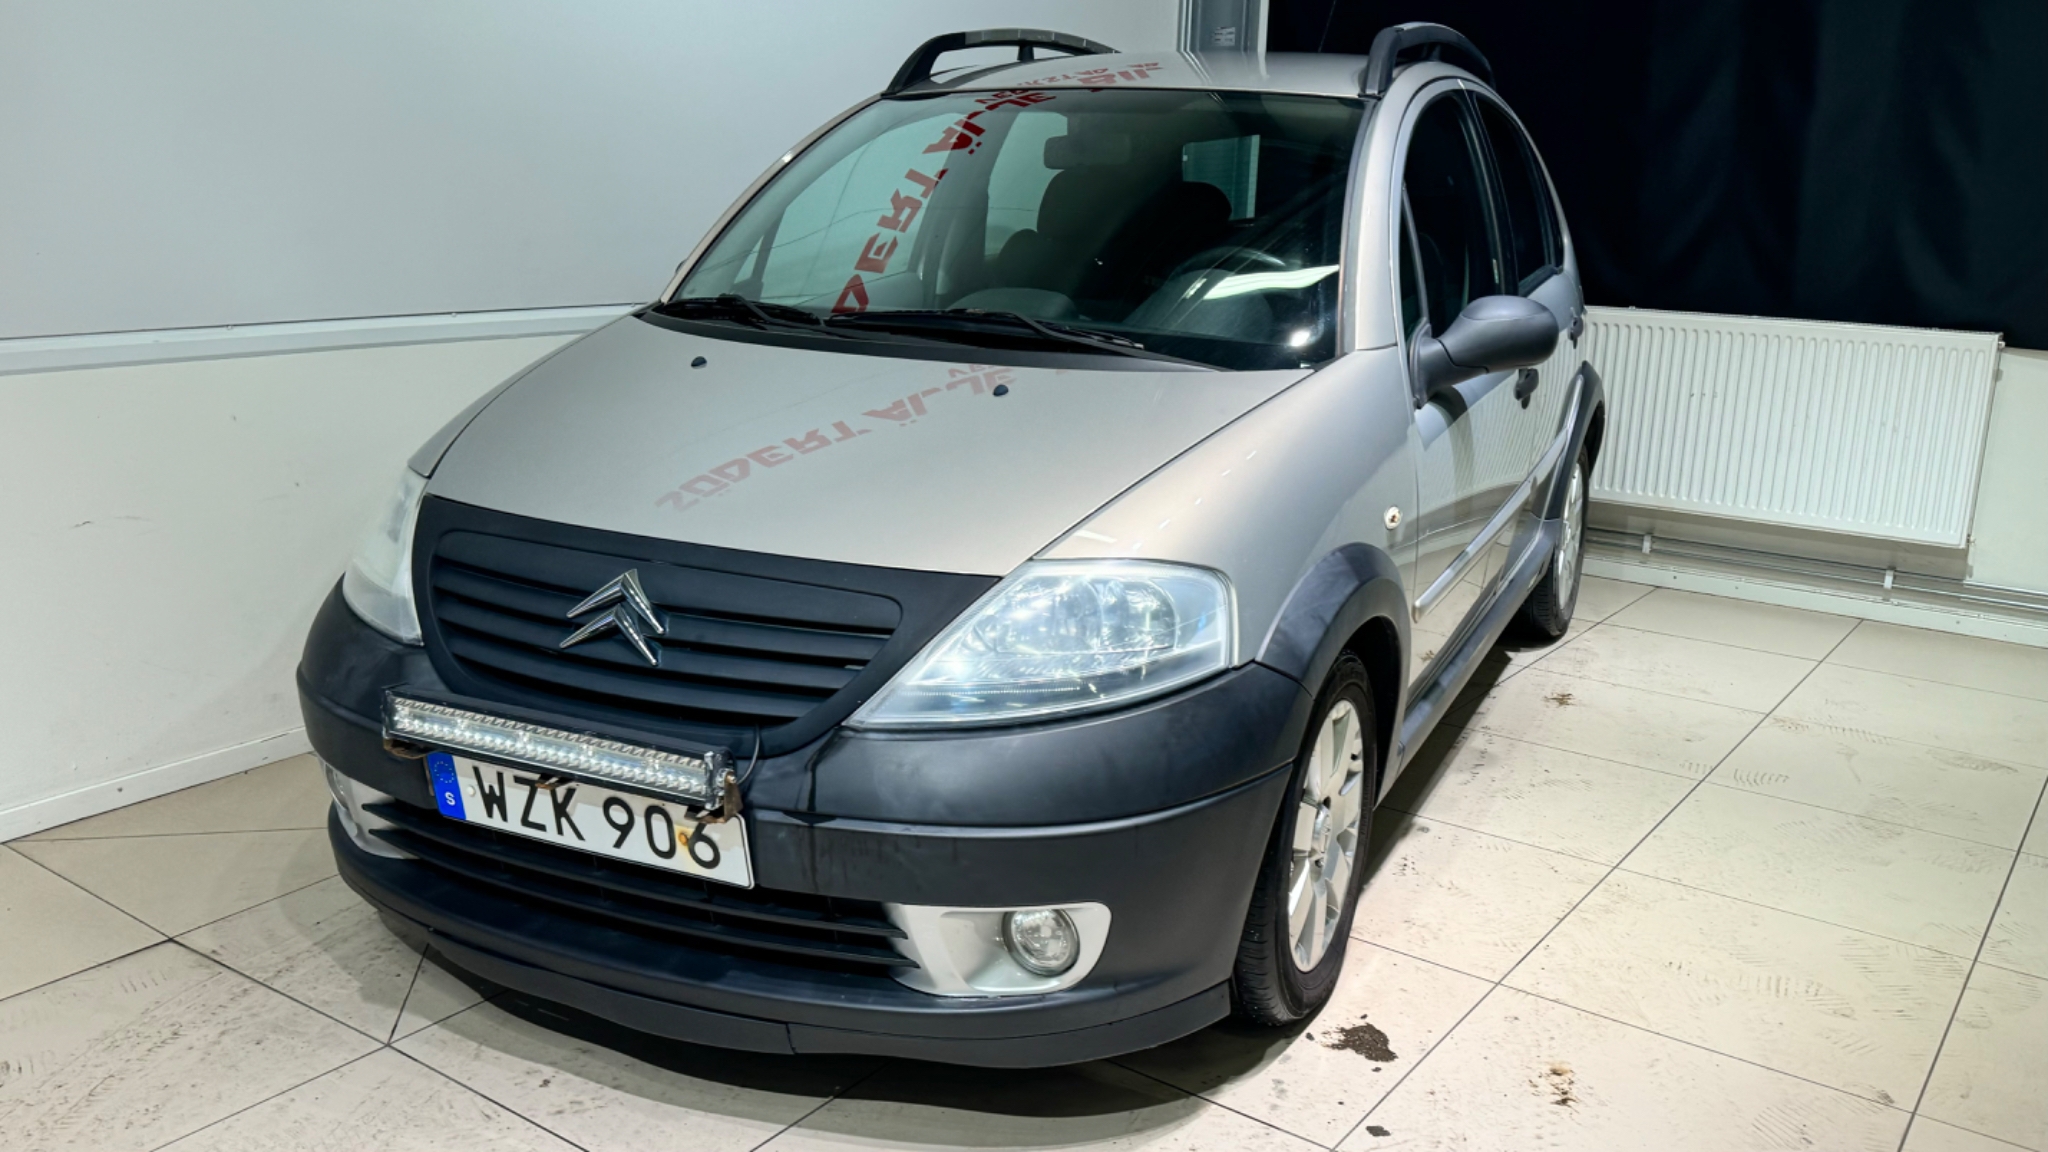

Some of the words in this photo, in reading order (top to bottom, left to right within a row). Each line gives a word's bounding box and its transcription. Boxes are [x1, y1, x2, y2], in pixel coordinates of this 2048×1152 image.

[444, 791, 456, 806] S
[472, 765, 586, 842] WZK
[602, 796, 721, 870] 906
